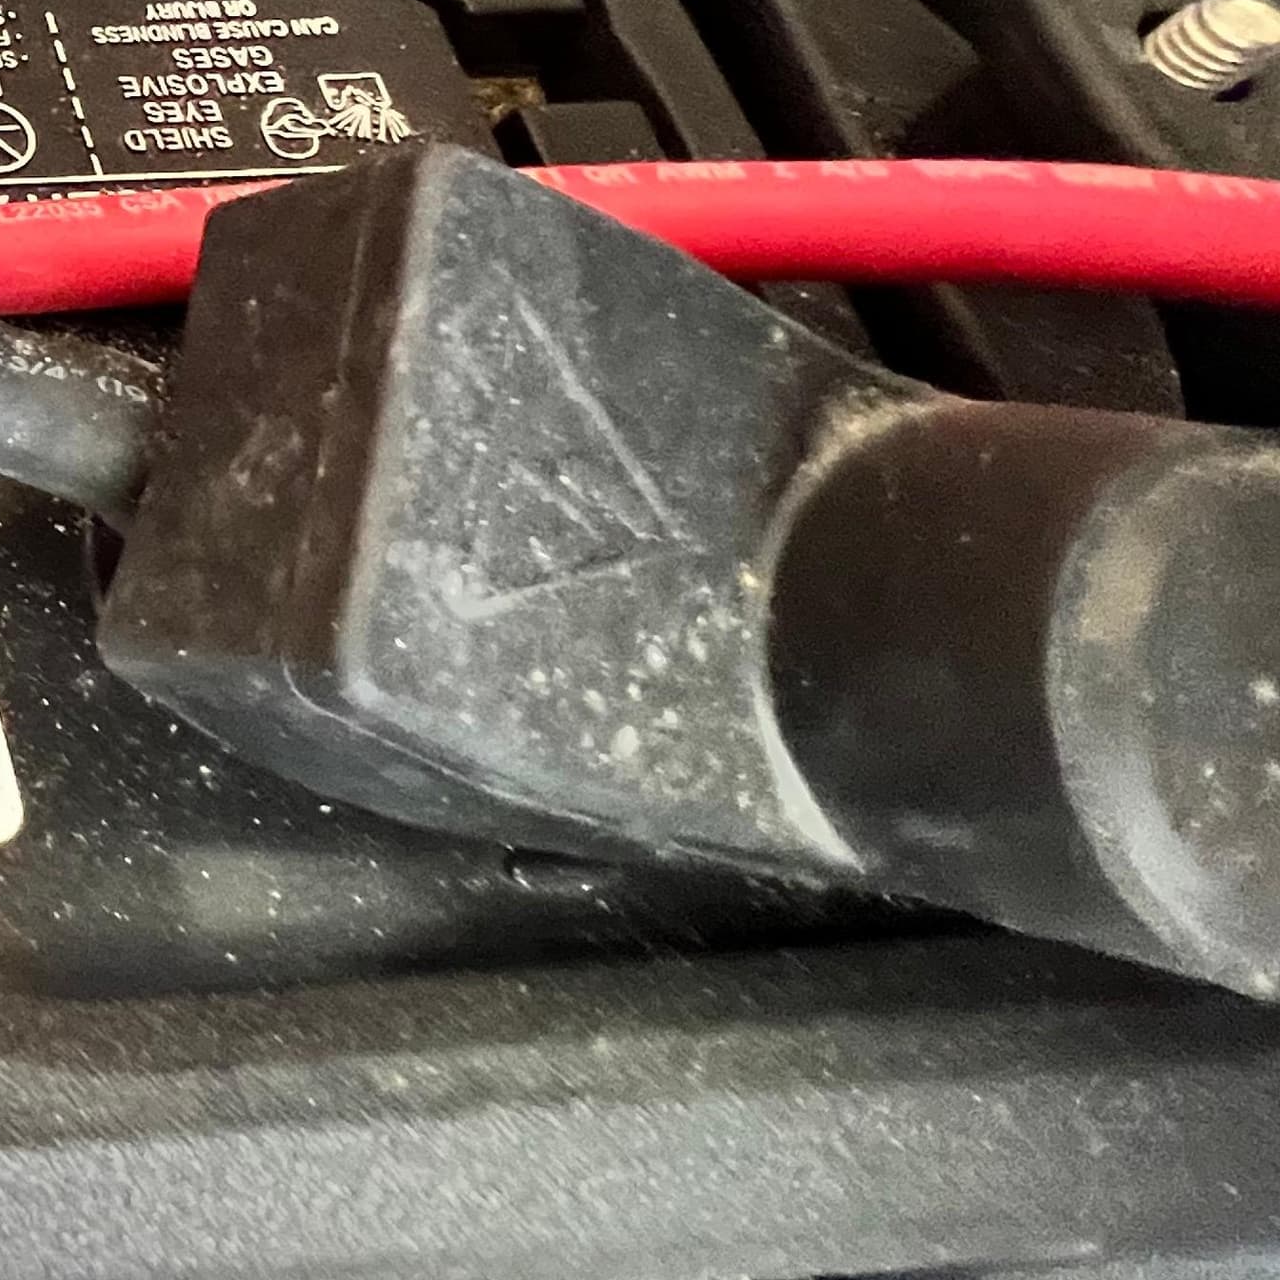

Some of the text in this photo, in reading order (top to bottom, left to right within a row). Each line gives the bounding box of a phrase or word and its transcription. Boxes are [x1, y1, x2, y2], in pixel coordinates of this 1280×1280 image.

[145, 0, 219, 21] INJURY
[91, 16, 339, 44] CAN CAUSE BLINDNESS
[171, 44, 273, 70] GASES
[117, 70, 285, 98] EXPLOSIVE
[142, 99, 224, 123] EYES
[123, 125, 234, 152] SHIELD
[120, 190, 185, 213] CSA
